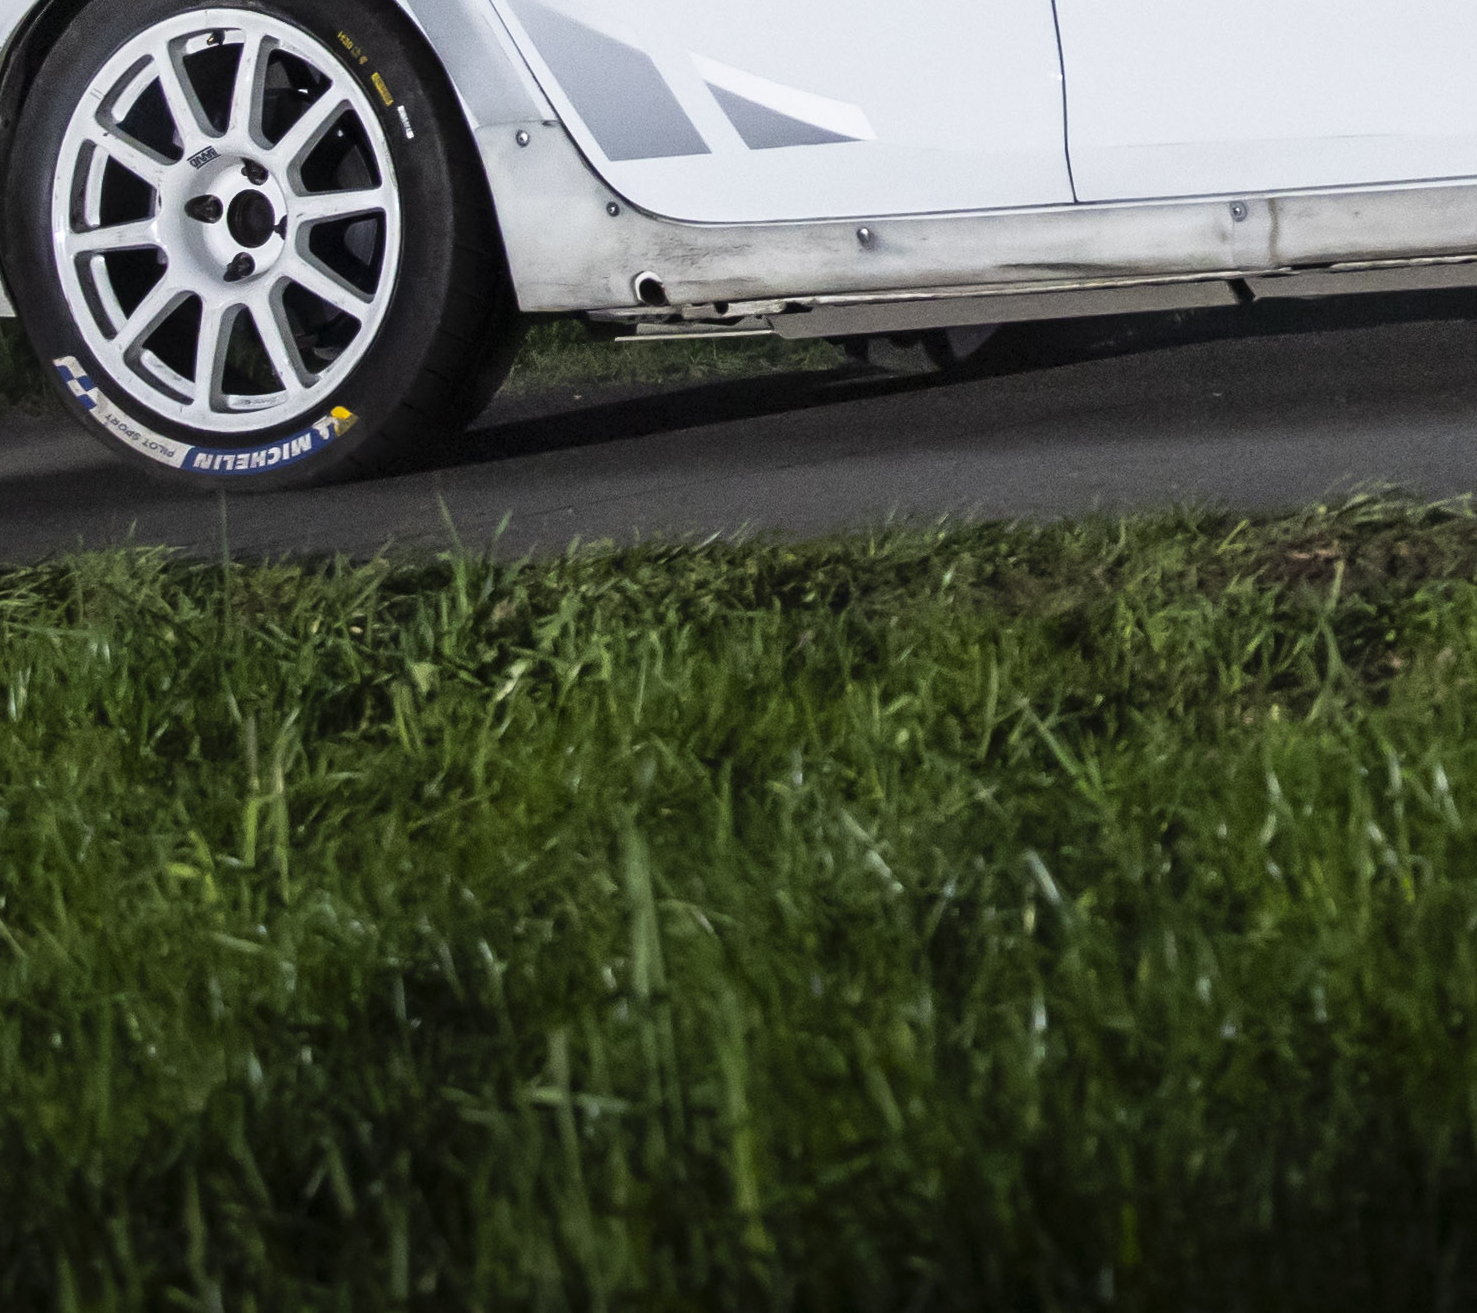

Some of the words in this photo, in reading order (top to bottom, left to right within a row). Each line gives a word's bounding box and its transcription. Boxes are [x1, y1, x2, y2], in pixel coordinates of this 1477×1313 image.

[105, 413, 142, 441] SPORT
[142, 439, 176, 458] PILOT
[193, 433, 313, 471] MICHELIN
